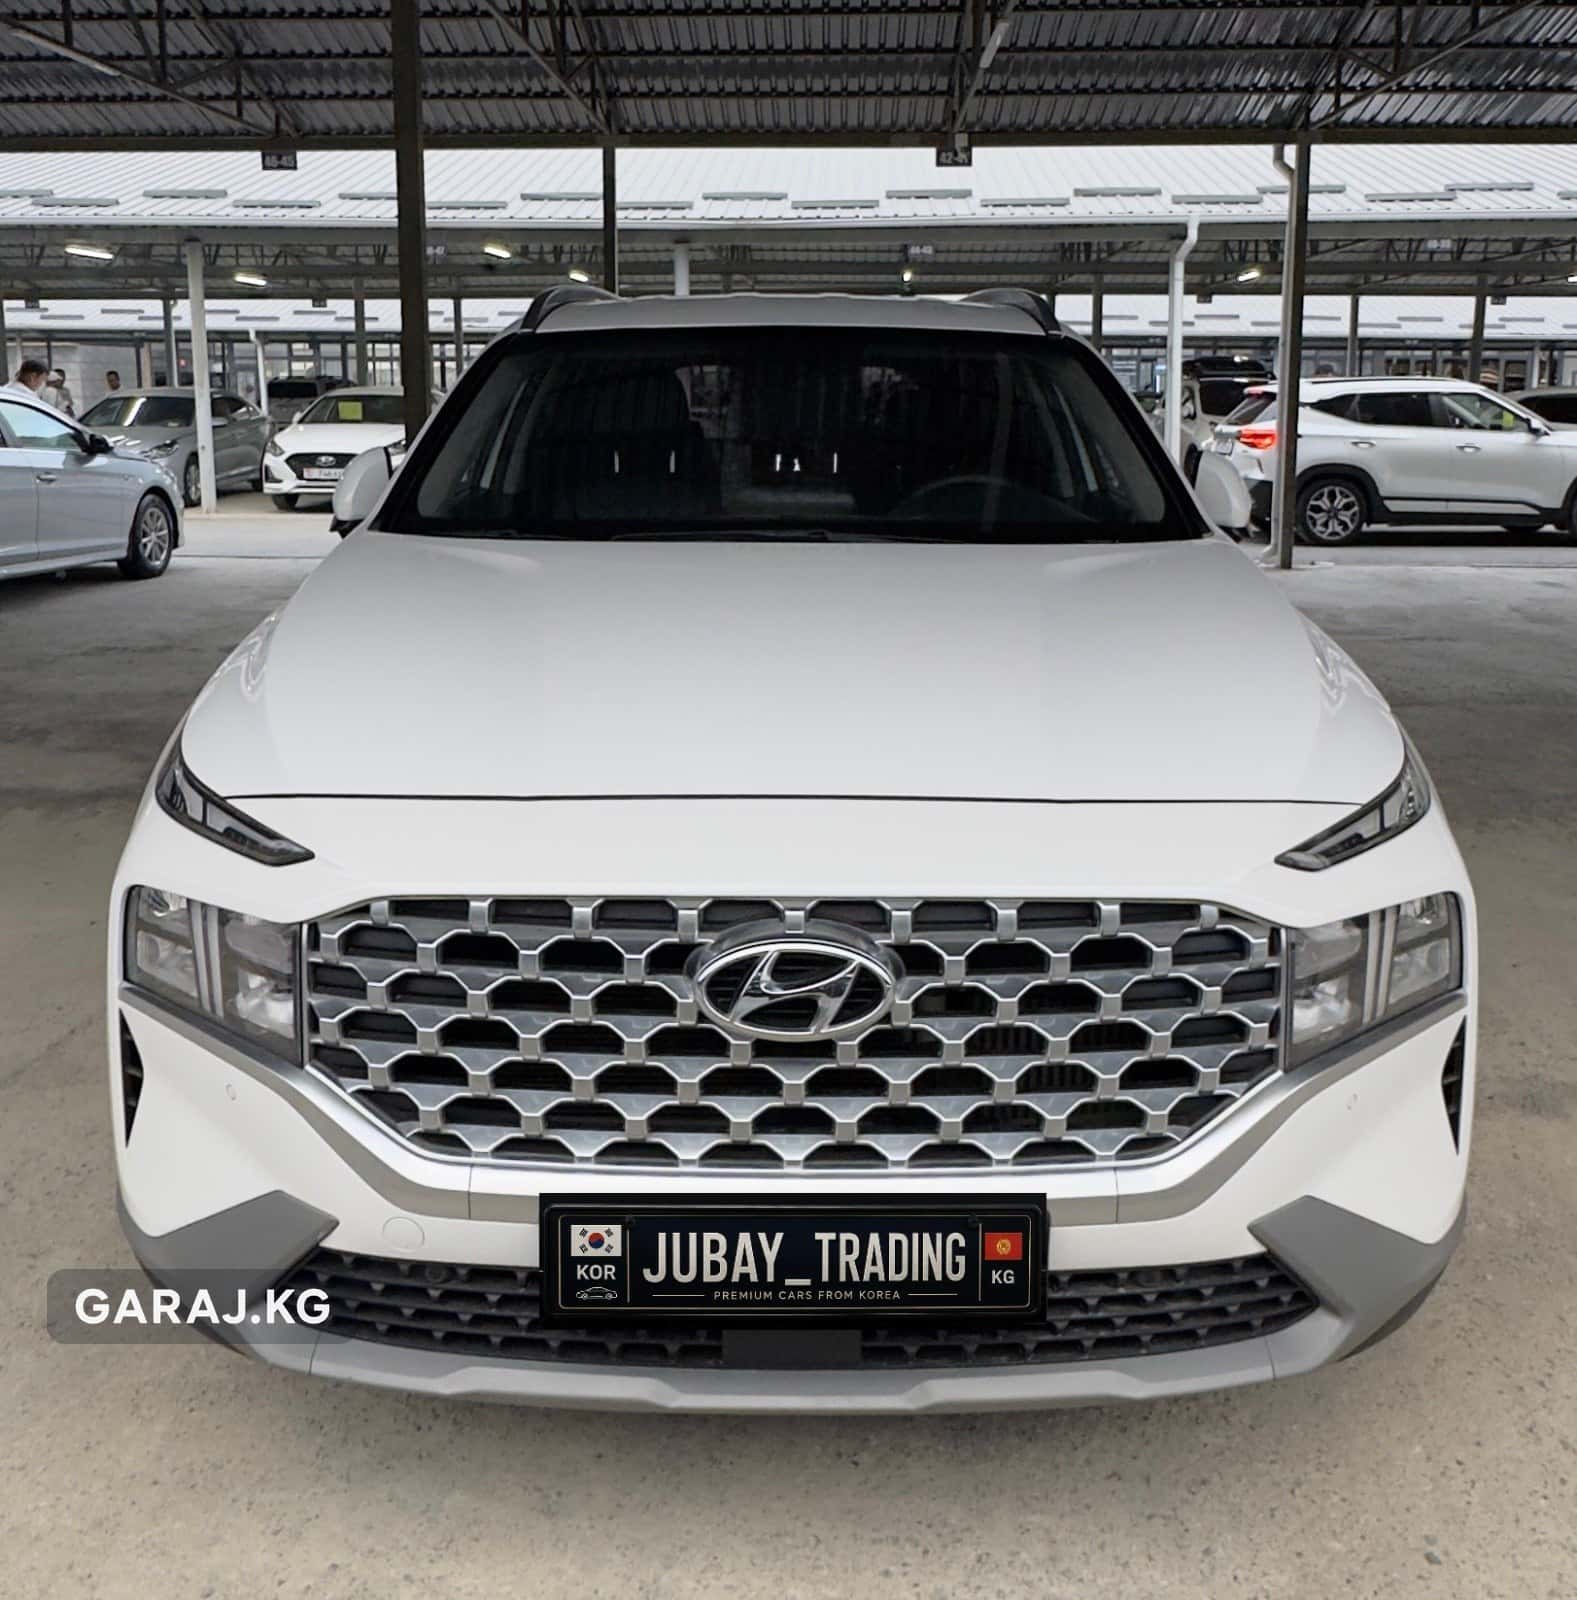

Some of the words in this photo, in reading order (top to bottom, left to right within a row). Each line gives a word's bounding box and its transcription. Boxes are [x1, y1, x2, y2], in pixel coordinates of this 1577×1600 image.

[643, 1232, 966, 1285] JUBAY_TRADING
[576, 1264, 616, 1281] KOR
[991, 1269, 1016, 1285] KG
[714, 1290, 774, 1301] PREMIUM
[778, 1290, 813, 1301] CARS
[818, 1290, 853, 1301] FROM
[859, 1290, 901, 1301] KOREA
